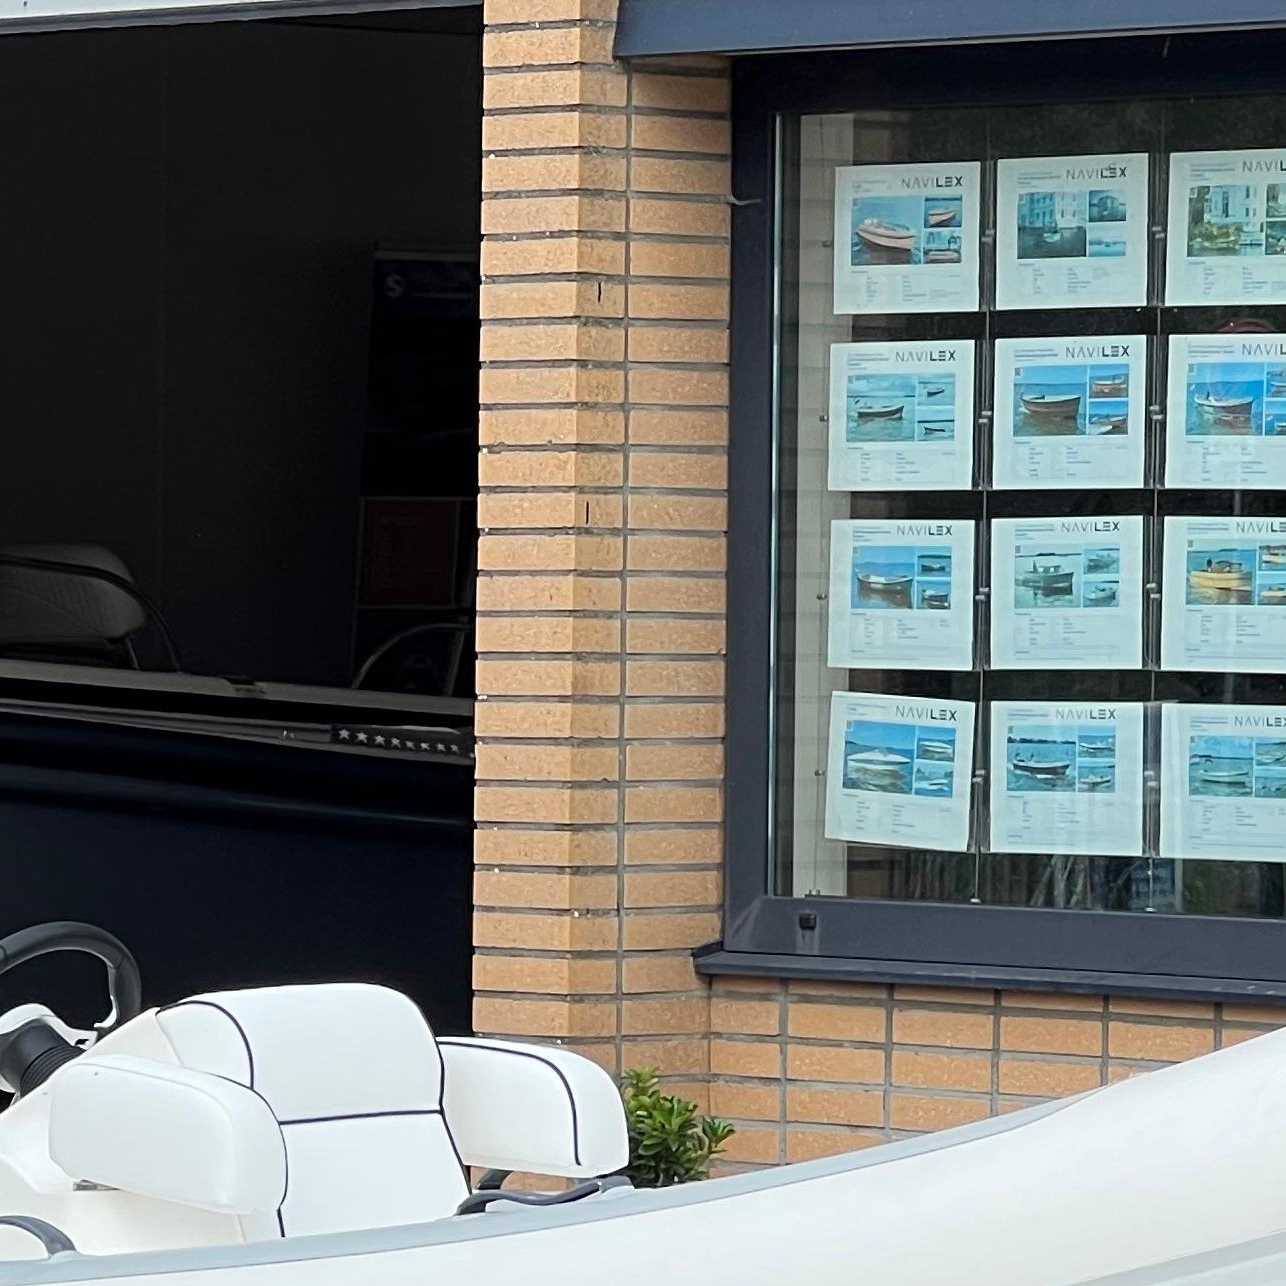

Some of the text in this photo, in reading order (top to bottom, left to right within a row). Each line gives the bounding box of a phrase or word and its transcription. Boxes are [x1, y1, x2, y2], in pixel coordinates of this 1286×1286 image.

[901, 176, 963, 188] NAVILEX
[895, 350, 956, 362] NAVILEX
[1066, 345, 1130, 358] NAVILEX
[897, 525, 952, 536] NAVILEX
[1061, 521, 1120, 532] NAVILEX
[895, 705, 957, 721] NAVILEX
[1056, 709, 1116, 720] NAVILEX
